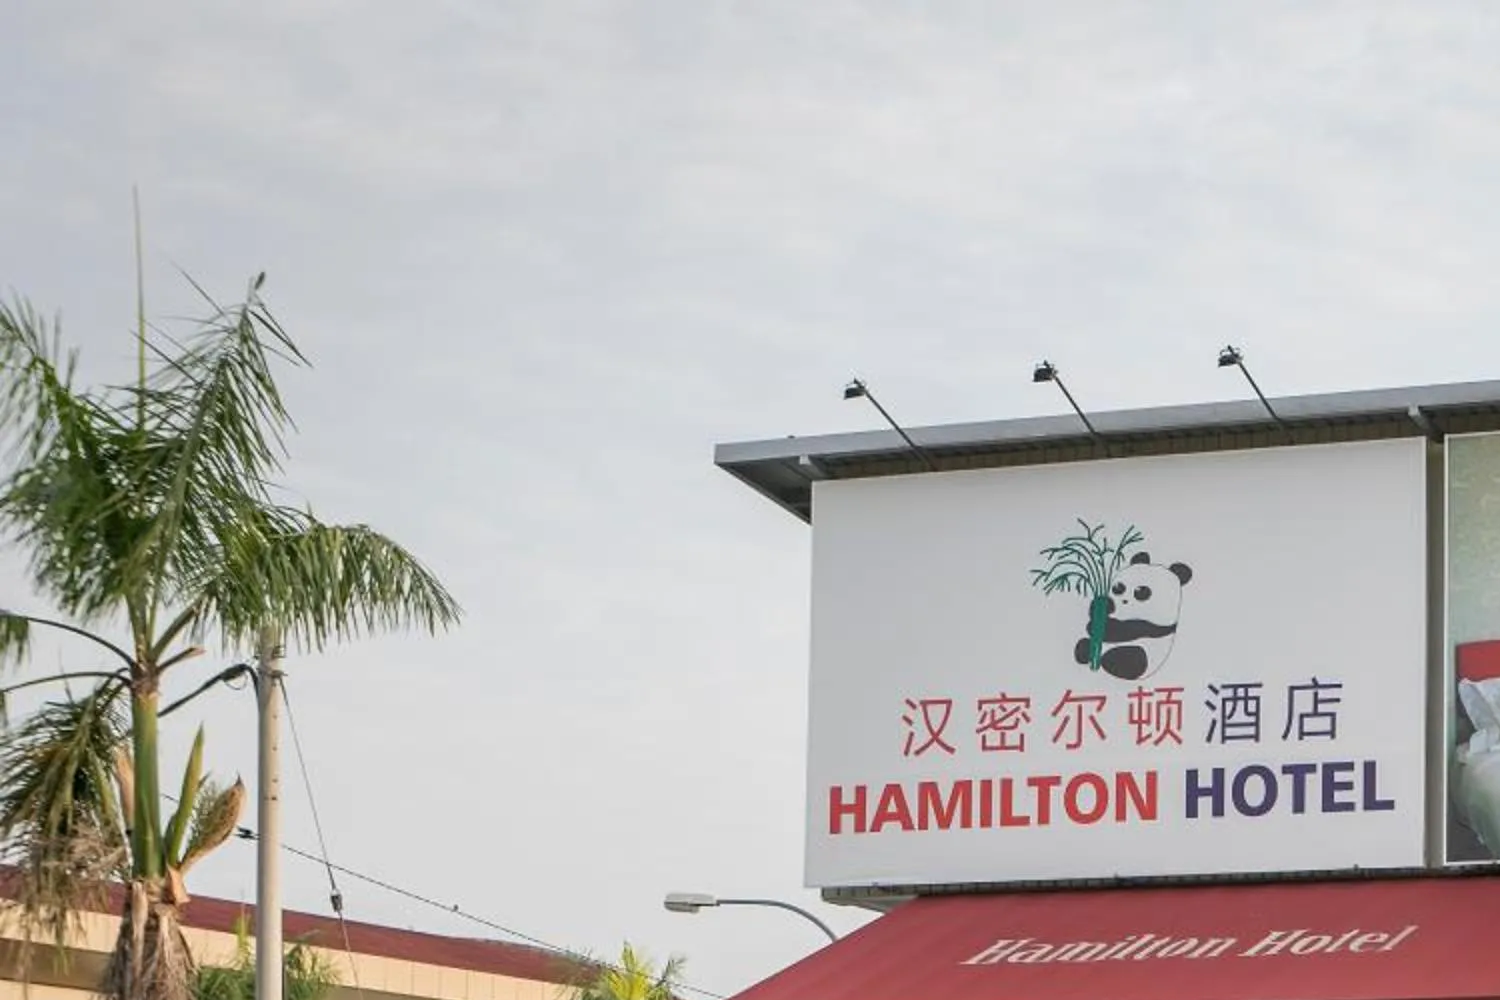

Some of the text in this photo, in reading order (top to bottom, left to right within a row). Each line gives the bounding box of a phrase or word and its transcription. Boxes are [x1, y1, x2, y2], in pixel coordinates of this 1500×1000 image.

[901, 676, 1343, 757] 汉密尔顿酒店
[828, 760, 1396, 835] HAMILTON HOTEL
[960, 925, 1419, 965] Hamilton Hotel
